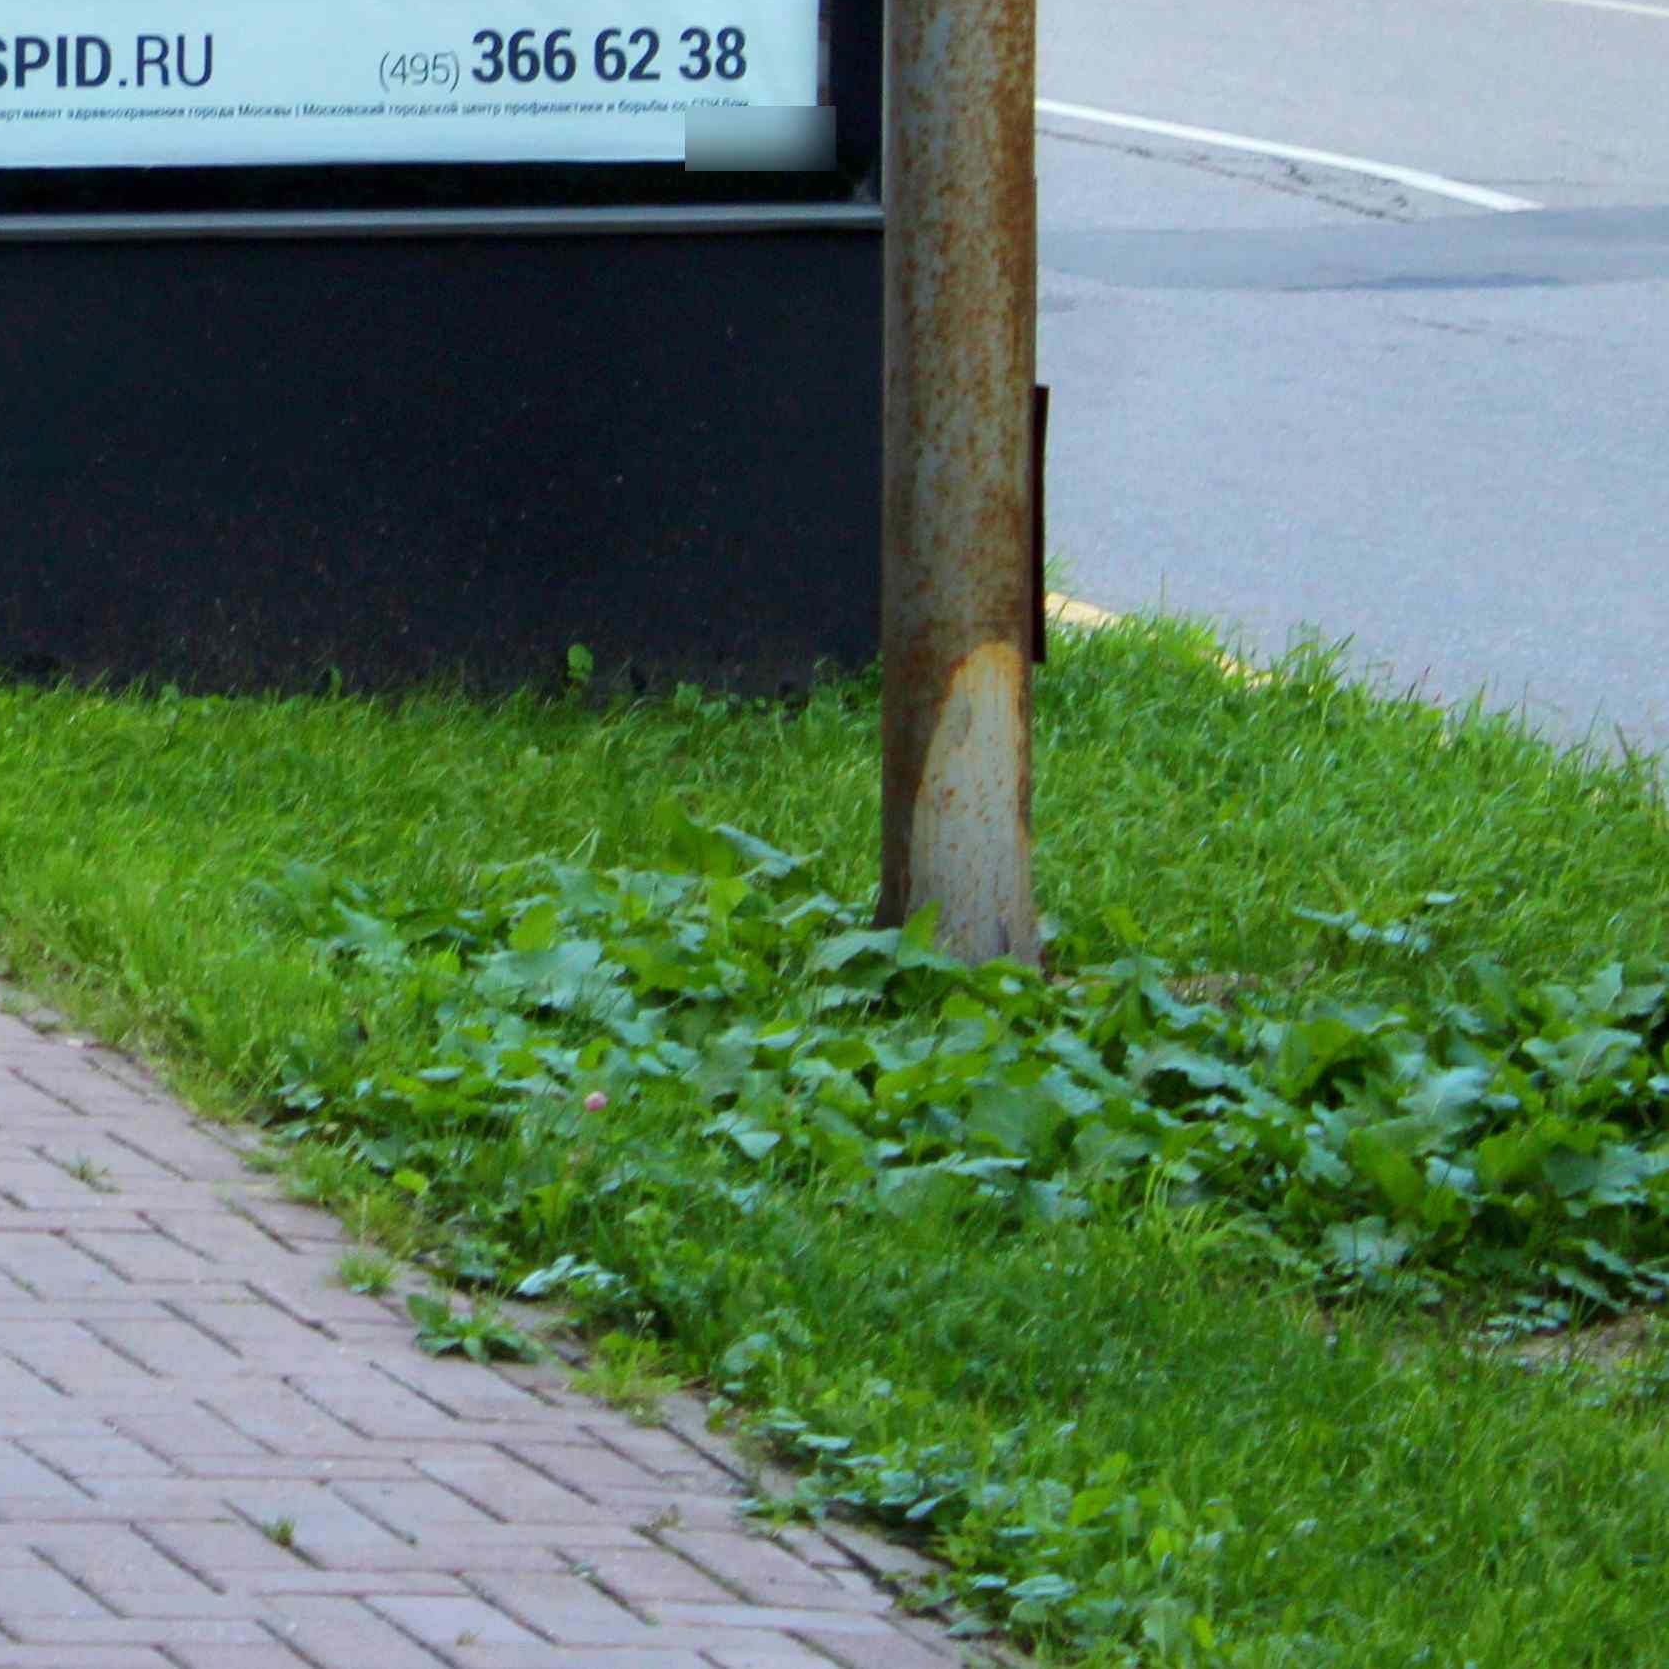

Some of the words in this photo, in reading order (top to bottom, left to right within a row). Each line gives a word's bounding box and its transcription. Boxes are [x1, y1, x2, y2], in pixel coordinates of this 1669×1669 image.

[378, 51, 460, 91] (495)
[470, 28, 577, 85] 366
[592, 27, 662, 83] 62
[678, 26, 748, 82] 38
